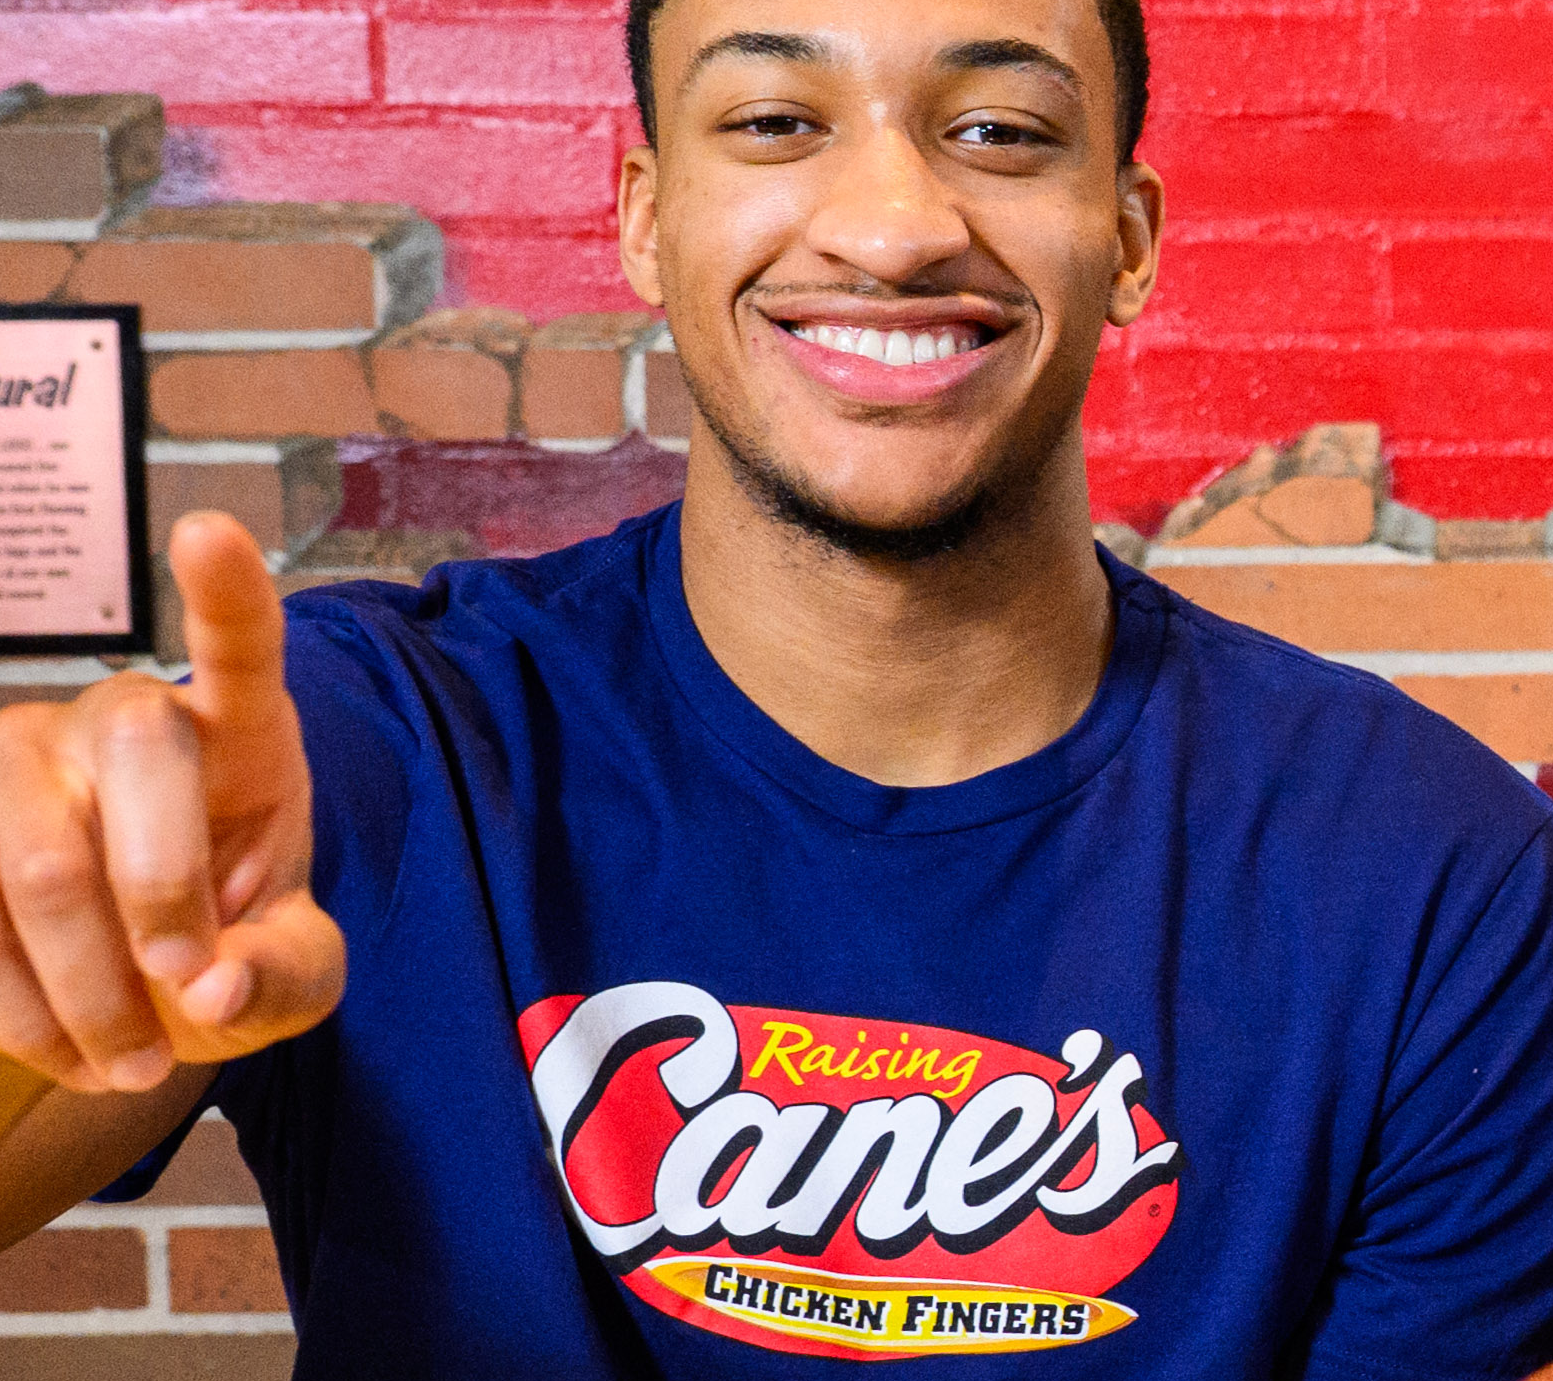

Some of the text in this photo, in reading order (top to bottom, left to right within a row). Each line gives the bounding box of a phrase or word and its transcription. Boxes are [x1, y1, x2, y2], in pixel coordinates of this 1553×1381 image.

[748, 1019, 984, 1099] Raising
[531, 980, 1181, 1256] Cane's
[703, 1263, 1089, 1338] CHICKEN FINGERS
